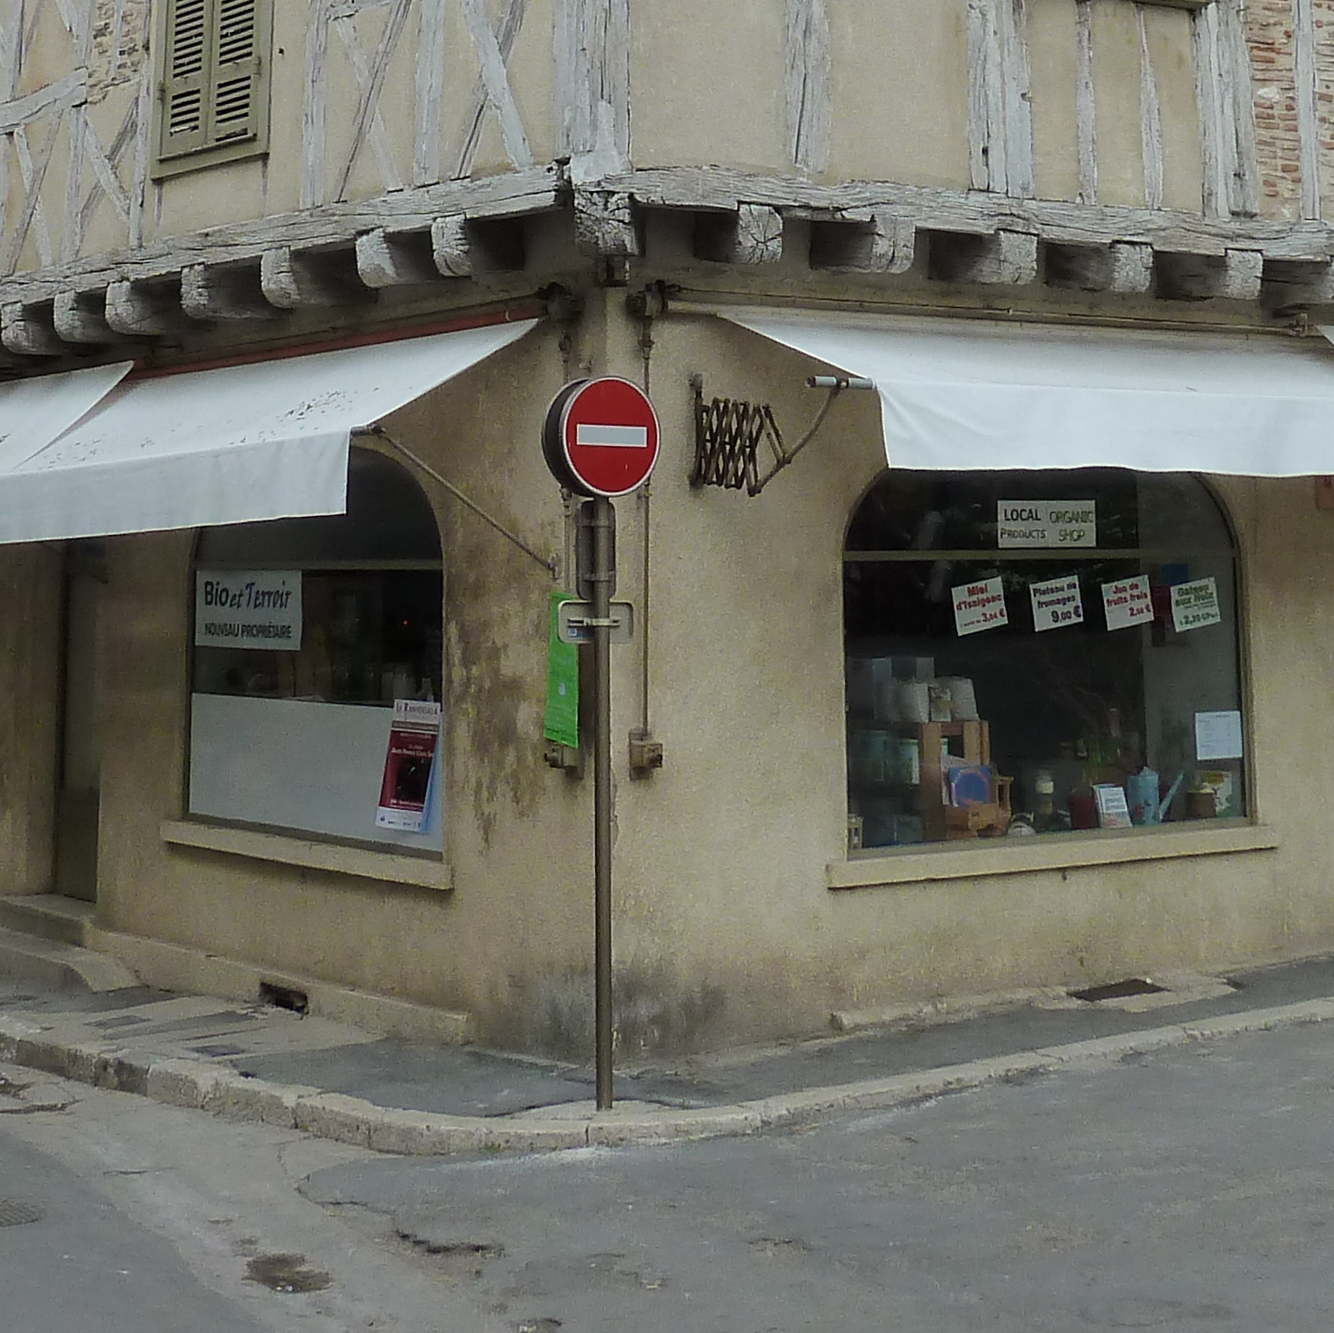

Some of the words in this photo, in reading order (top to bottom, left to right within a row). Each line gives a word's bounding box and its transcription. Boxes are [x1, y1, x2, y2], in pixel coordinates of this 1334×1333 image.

[1004, 508, 1042, 522] LOCAL
[1049, 511, 1095, 524] ORGANIC
[1000, 527, 1047, 540] PRODUCTS
[1058, 529, 1086, 542] SHOP
[204, 580, 230, 607] Bio
[229, 589, 245, 609] et
[245, 580, 293, 610] Terroir
[1050, 609, 1073, 624] 9,00
